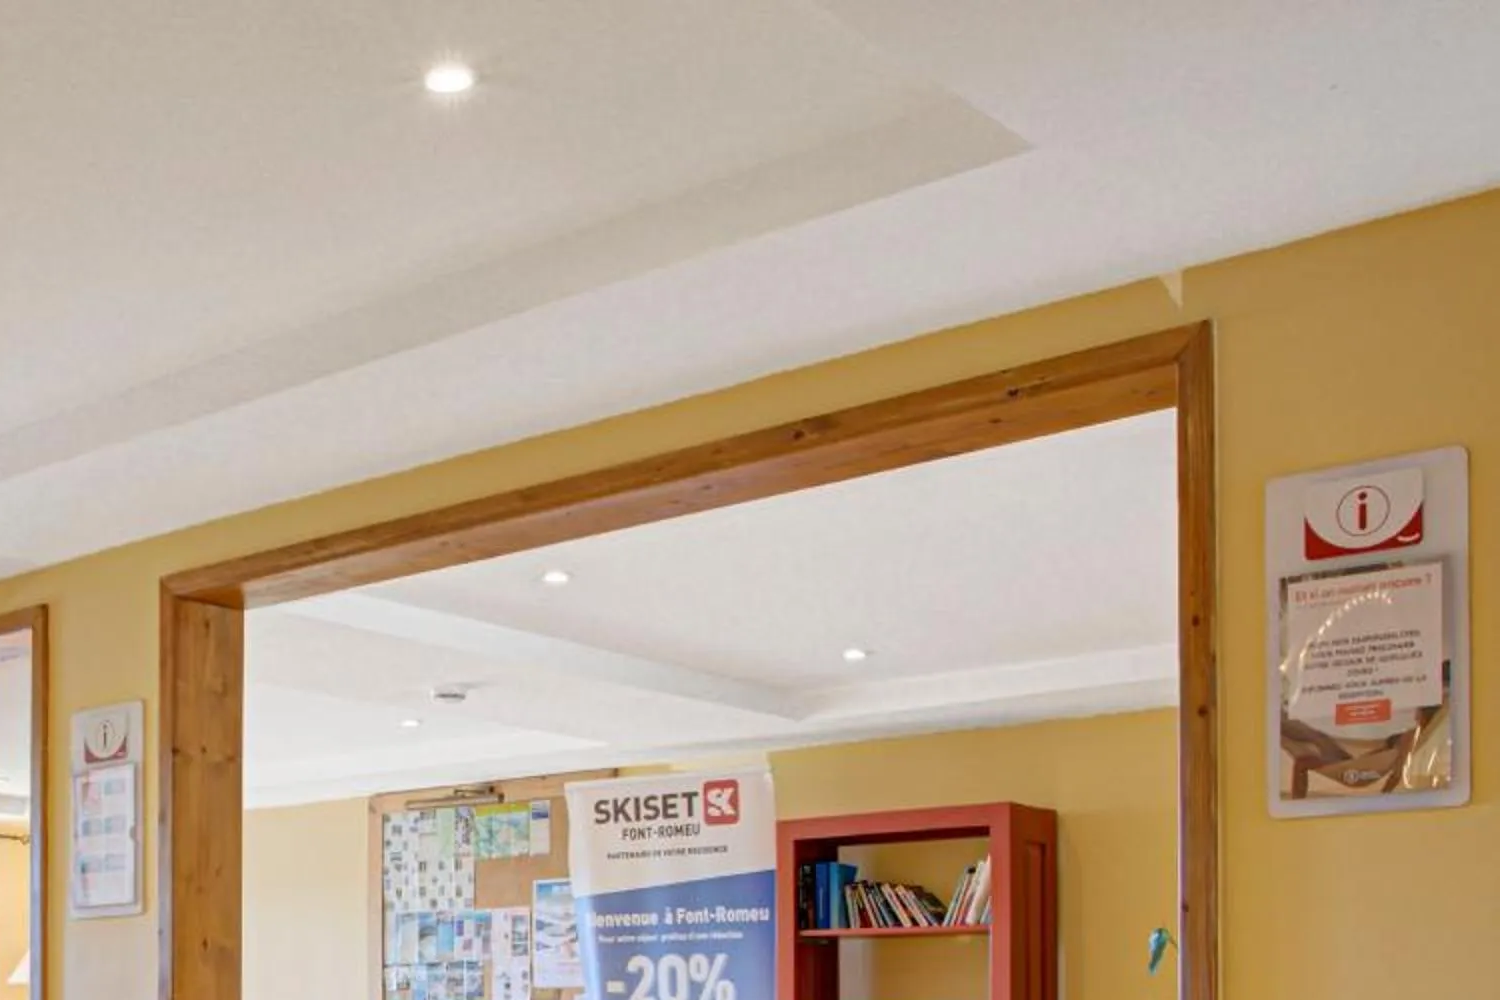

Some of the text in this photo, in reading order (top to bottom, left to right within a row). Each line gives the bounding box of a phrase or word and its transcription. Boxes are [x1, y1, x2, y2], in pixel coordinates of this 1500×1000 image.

[594, 790, 699, 825] SKISET
[621, 823, 702, 841] FONT-ROMEU
[675, 905, 771, 925] Font-Romeu
